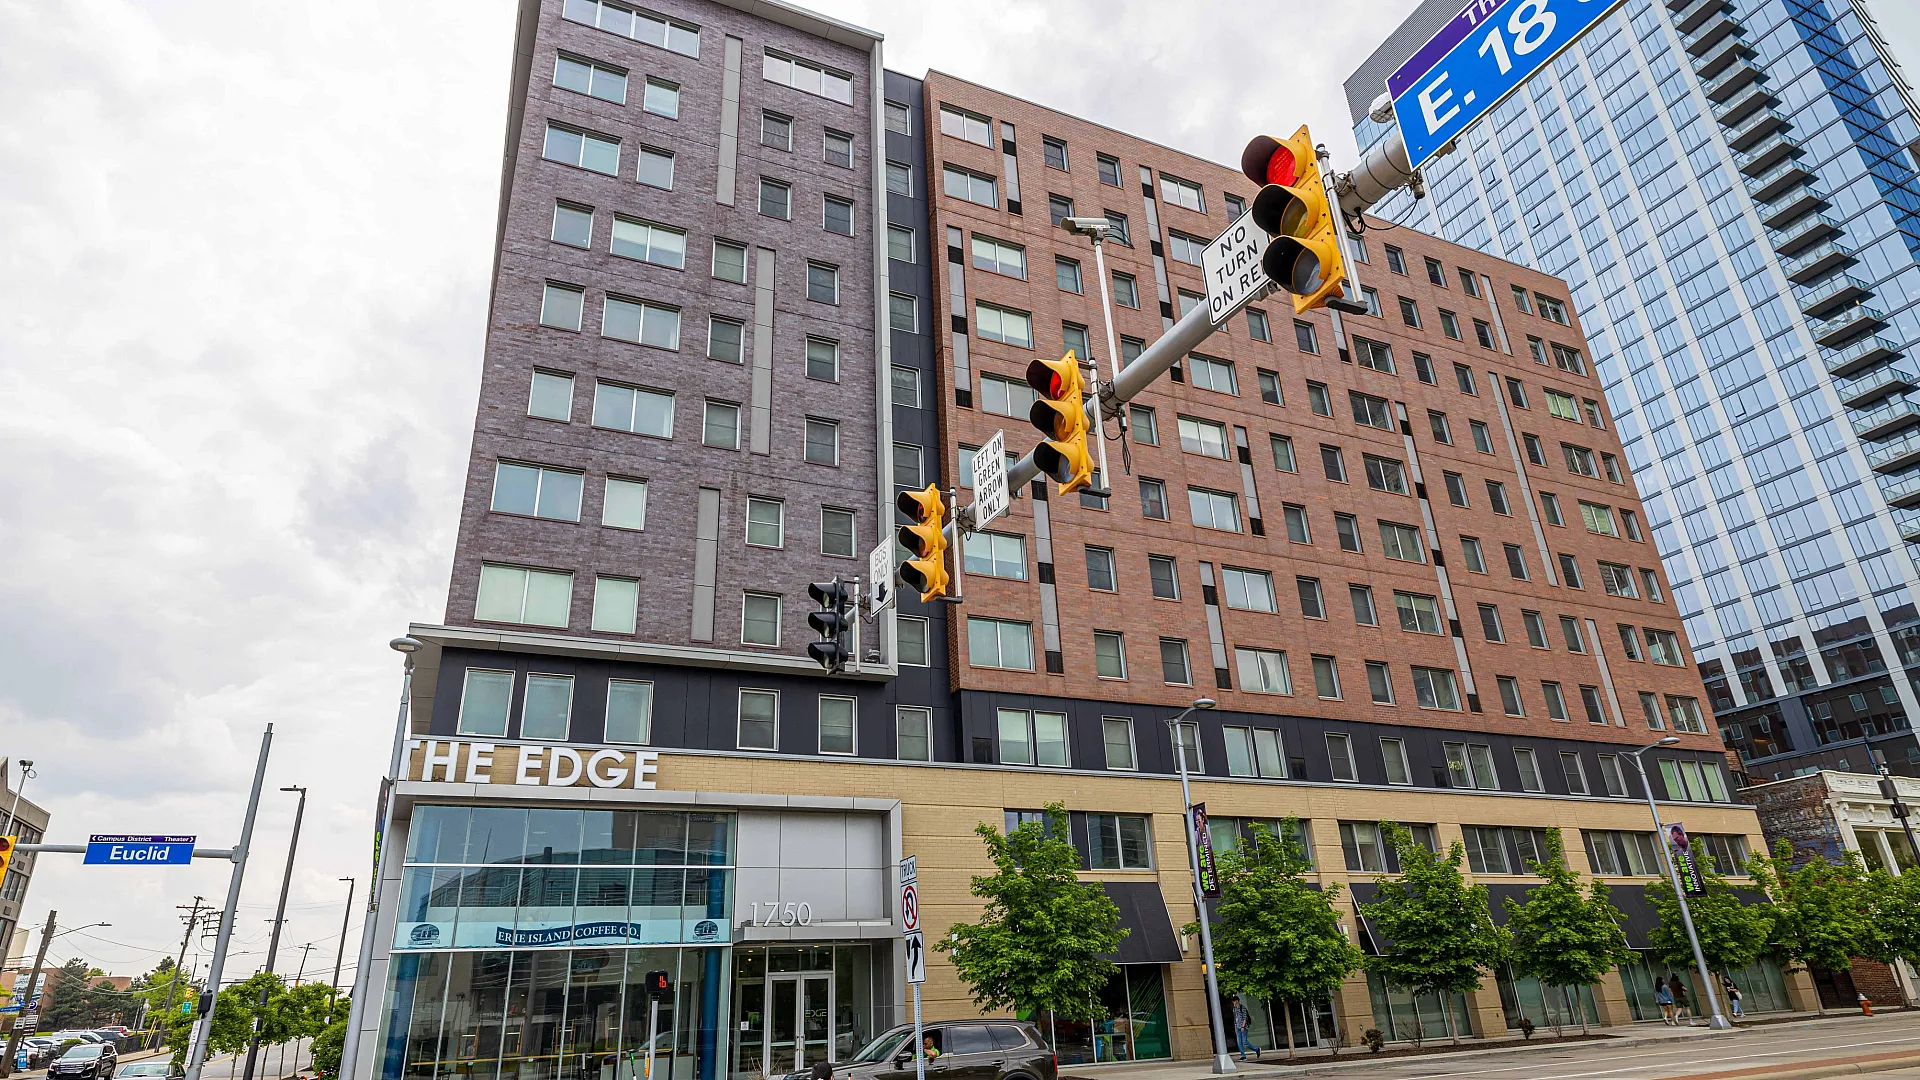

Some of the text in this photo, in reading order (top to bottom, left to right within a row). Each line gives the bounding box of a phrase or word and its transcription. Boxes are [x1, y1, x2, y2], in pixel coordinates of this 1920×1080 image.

[1417, 0, 1557, 136] E. 18
[1220, 226, 1246, 258] NO
[1216, 239, 1258, 284] TURN
[1212, 259, 1266, 313] ON RE
[973, 436, 1002, 473] LEFT ON
[978, 456, 1001, 487] GREEN
[979, 472, 1003, 506] ARROW
[983, 493, 1001, 520] ONLY
[875, 546, 886, 566] BUS
[874, 560, 888, 584] ONLY
[397, 740, 659, 789] THE EDGE
[109, 845, 170, 861] Euclid
[1202, 832, 1216, 891] DETERMINED
[900, 860, 915, 878] TRUCK
[1202, 871, 1209, 891] we
[1678, 855, 1694, 892] we are
[1683, 850, 1701, 892] INNOVATIVE
[750, 901, 812, 927] 1750
[498, 925, 640, 943] ERIE ISLAND COFFEE CO.
[805, 1009, 828, 1018] EDGE
